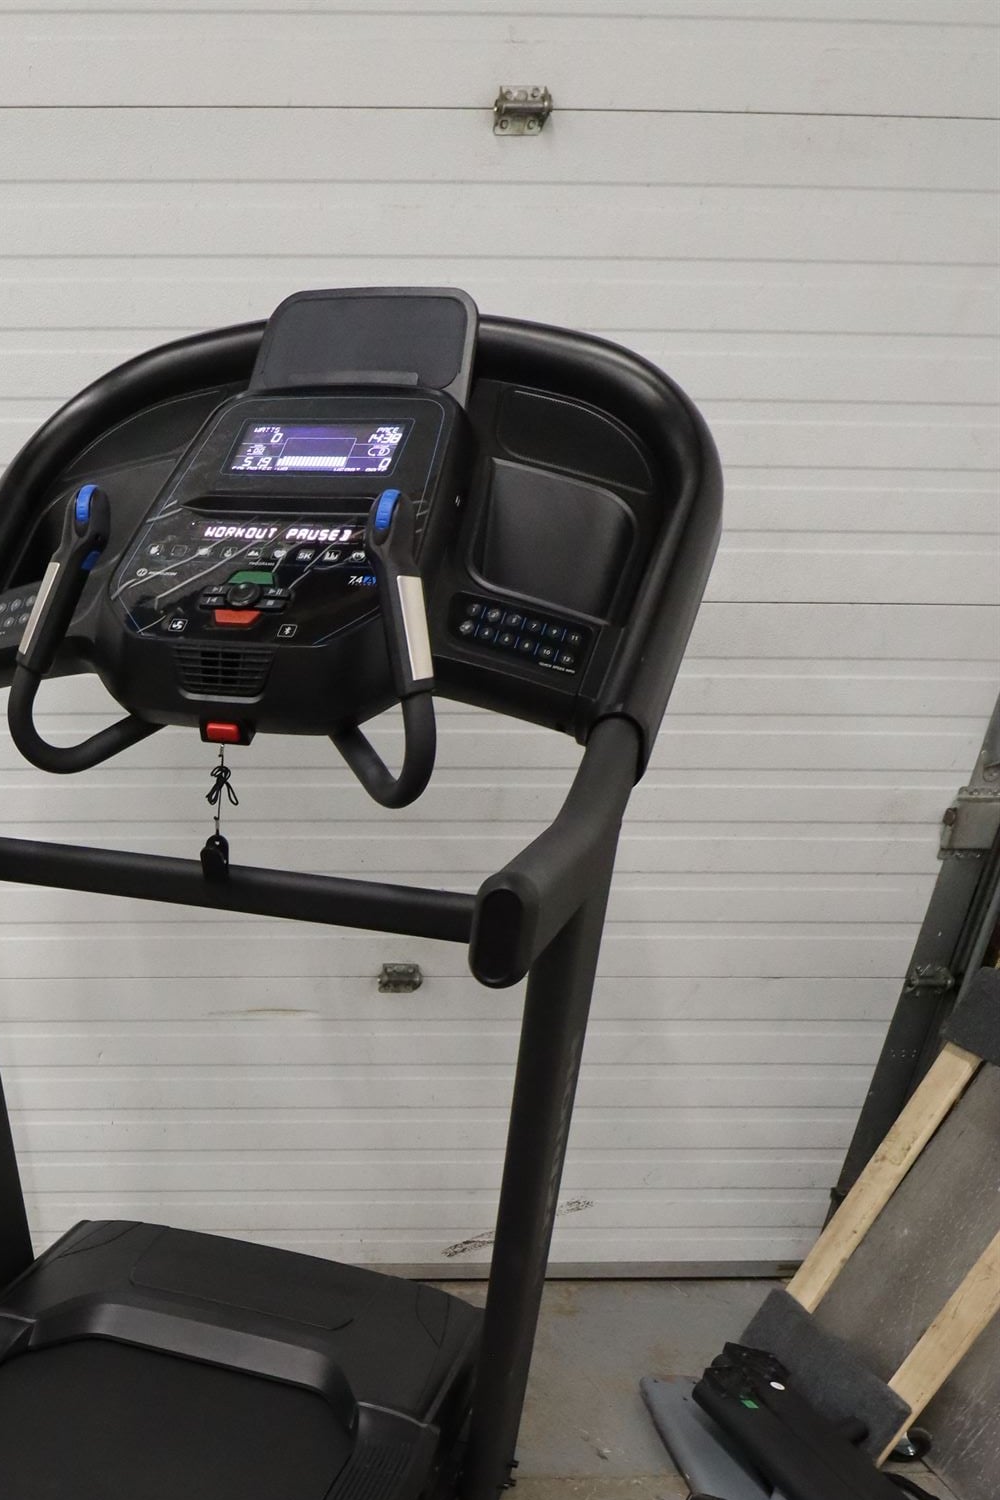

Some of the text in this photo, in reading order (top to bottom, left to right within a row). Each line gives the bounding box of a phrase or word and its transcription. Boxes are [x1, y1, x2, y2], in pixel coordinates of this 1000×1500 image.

[270, 433, 284, 443] 0
[378, 457, 392, 469] 0
[204, 526, 352, 542] WORKOUT PAUSED
